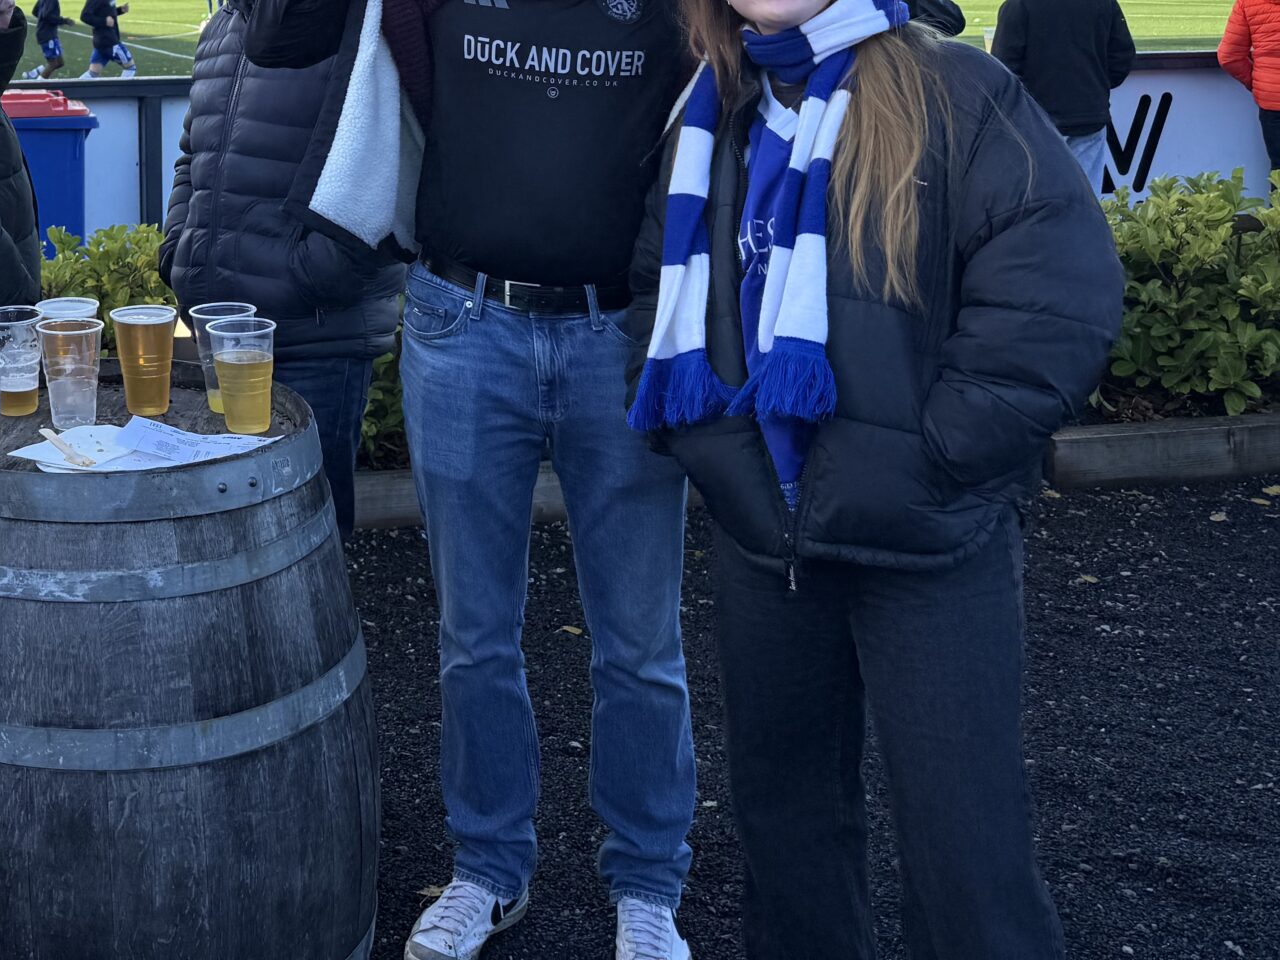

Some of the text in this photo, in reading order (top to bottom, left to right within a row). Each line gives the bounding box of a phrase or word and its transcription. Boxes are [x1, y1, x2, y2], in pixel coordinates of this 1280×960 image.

[524, 45, 571, 74] AND
[576, 49, 645, 76] COVER
[488, 68, 618, 87] DUCKANDCOVER.COUK
